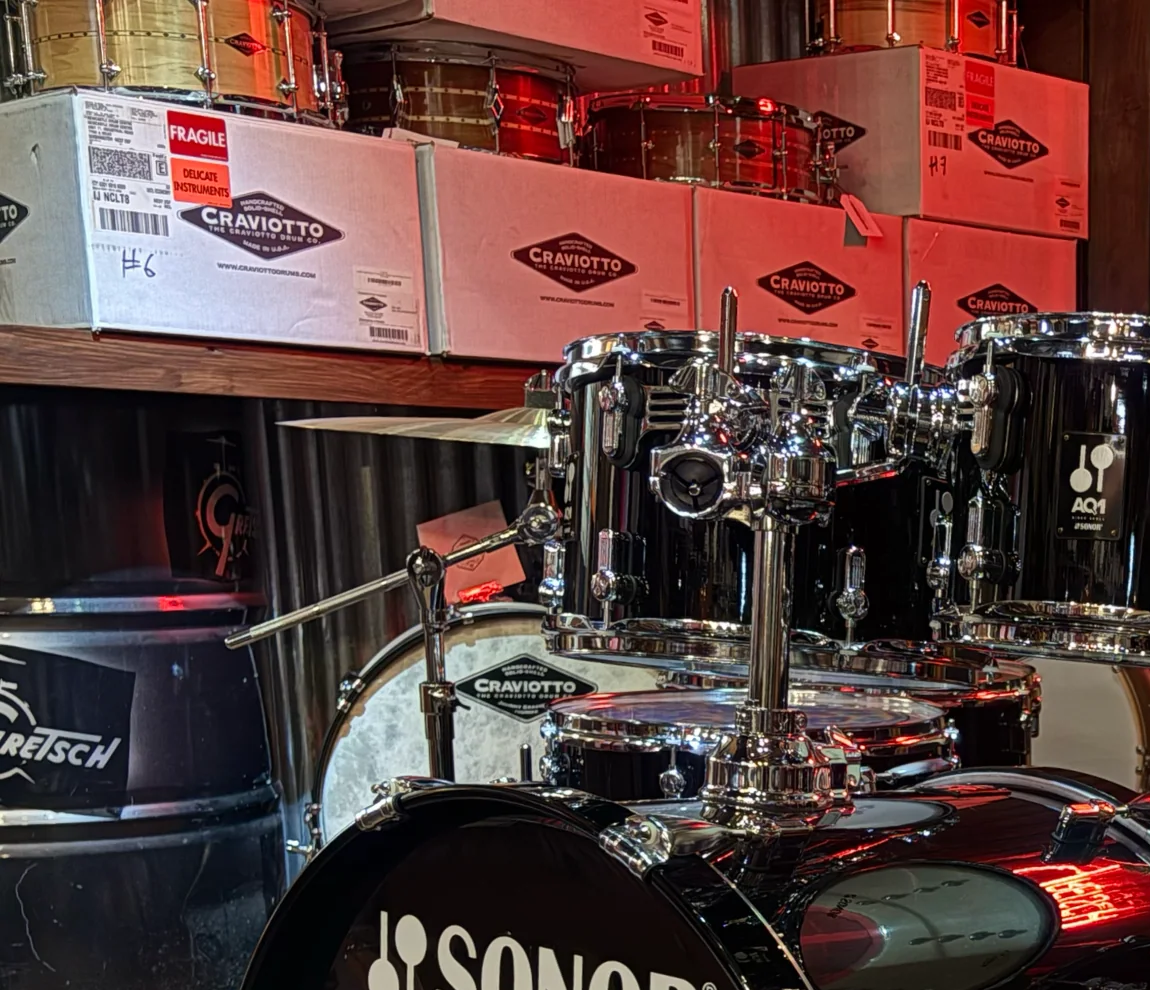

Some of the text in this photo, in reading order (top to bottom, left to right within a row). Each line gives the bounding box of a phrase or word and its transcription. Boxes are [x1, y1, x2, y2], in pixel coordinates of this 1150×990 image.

[967, 70, 993, 87] FRAGILE
[169, 124, 226, 148] FRAGILE
[978, 130, 1040, 154] CRAVIOTTO
[182, 168, 218, 183] DELICATE
[173, 181, 230, 198] INSTRUMENTS
[240, 199, 285, 211] HANDCRAFTED
[201, 206, 324, 238] CRAVIOTTO
[208, 226, 226, 234] THE
[229, 227, 276, 240] CRAVIOTTO
[280, 234, 303, 243] DRUM
[242, 240, 261, 251] MADE
[528, 247, 622, 272] CRAVIOTTO
[770, 275, 845, 295] CRAVIOTTO
[967, 297, 1029, 314] CRAVIOTTO
[1071, 497, 1107, 515] AQ1
[474, 678, 577, 693] CRAVIOTTO
